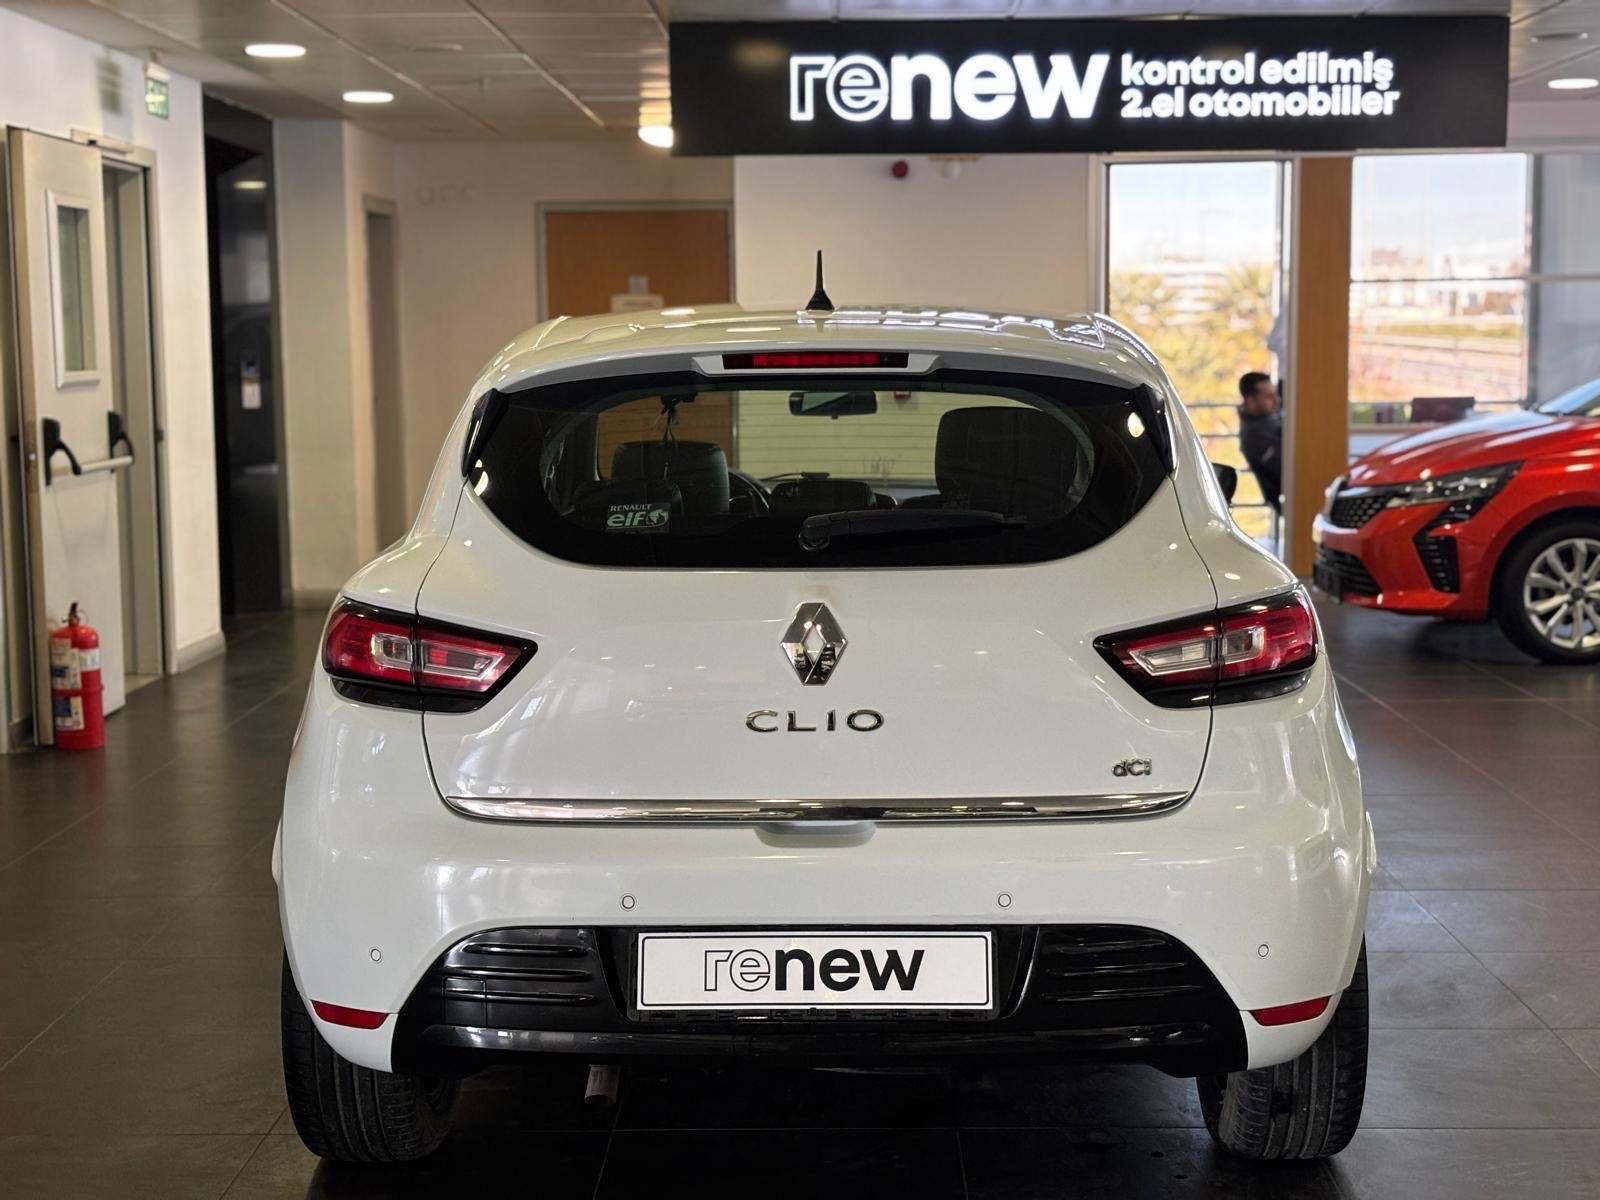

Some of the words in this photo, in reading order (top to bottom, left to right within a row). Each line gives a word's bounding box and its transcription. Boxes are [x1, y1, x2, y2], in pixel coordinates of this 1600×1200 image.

[1121, 52, 1255, 86] kontrol
[1260, 51, 1394, 91] edilmiş
[790, 54, 1110, 121] renew
[1120, 86, 1185, 118] 2.el
[1188, 84, 1400, 117] otomobiller
[606, 511, 647, 528] elf
[610, 503, 653, 512] RENAULT
[745, 708, 885, 733] CLIO
[1112, 758, 1153, 778] dCi
[703, 948, 926, 992] renew
